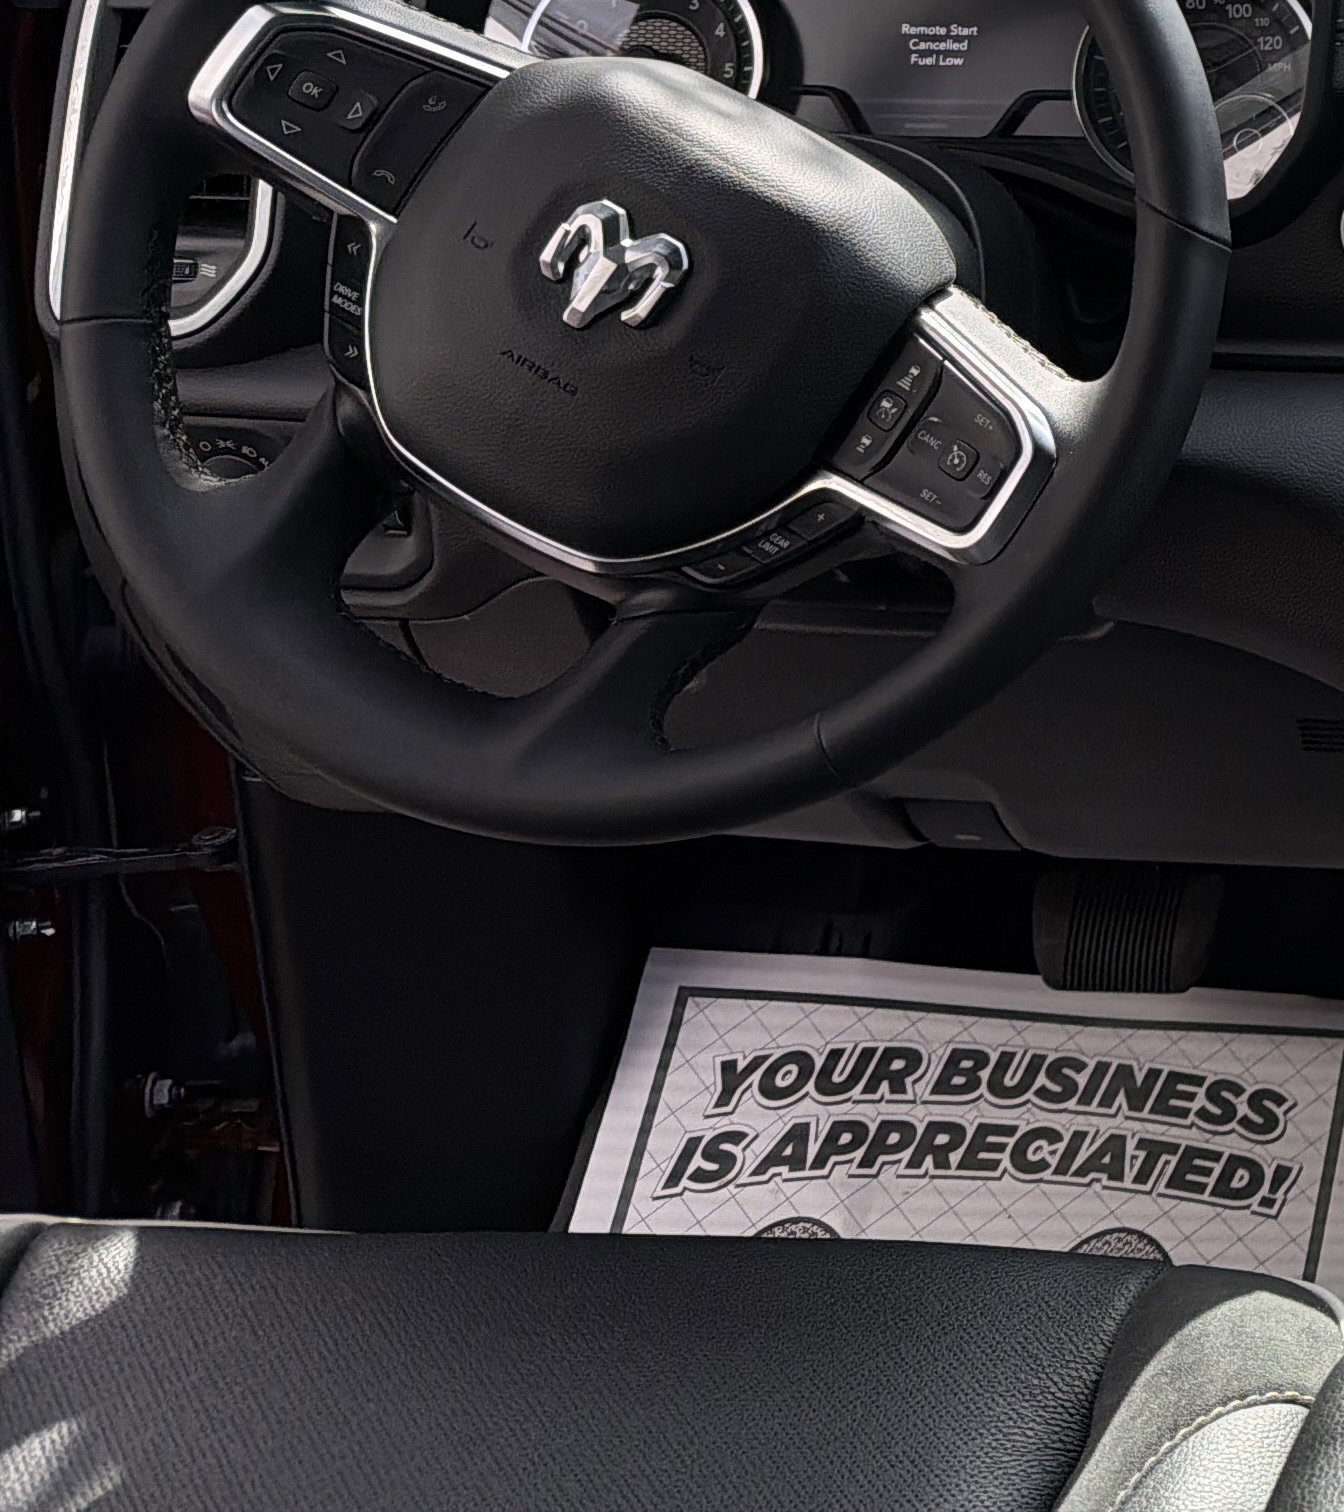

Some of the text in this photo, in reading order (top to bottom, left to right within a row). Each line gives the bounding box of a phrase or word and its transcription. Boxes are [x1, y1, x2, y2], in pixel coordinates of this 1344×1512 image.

[1225, 3, 1252, 19] 100
[901, 24, 978, 36] Remote Start
[1254, 17, 1270, 27] 110
[715, 22, 727, 39] 4
[909, 39, 968, 51] Cancelled
[1257, 36, 1282, 51] 120
[911, 53, 964, 66] Fuel Low
[1268, 62, 1292, 72] MPH
[724, 63, 735, 79] 5
[302, 82, 324, 99] OK
[333, 281, 360, 301] DRIVE
[332, 294, 362, 316] MODES
[502, 349, 579, 397] AIRBAG
[917, 430, 942, 450] CANC
[977, 469, 993, 486] RES
[757, 539, 780, 555] LIMIT
[769, 532, 790, 548] GEAR
[714, 1045, 1296, 1139] YOUR BUSINESS
[662, 1122, 1299, 1212] IS APPRECIATED!
